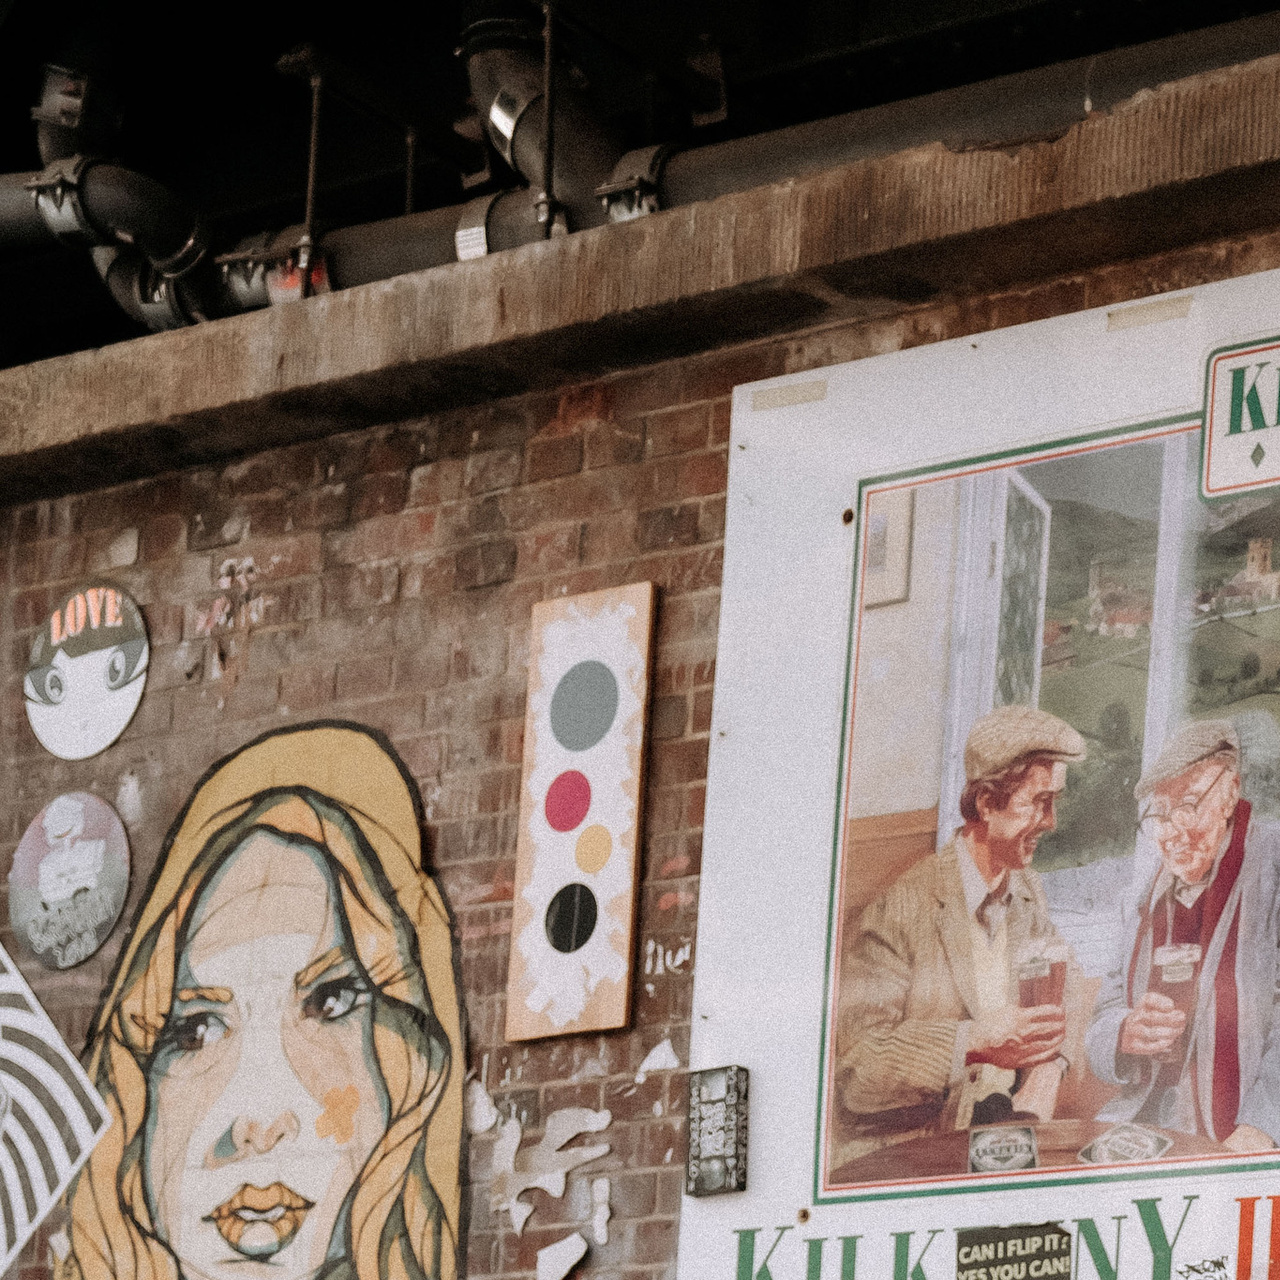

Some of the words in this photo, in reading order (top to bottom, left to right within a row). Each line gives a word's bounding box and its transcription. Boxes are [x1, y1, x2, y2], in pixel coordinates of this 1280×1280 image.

[50, 586, 122, 647] LOVE
[958, 1242, 995, 1265] CAN
[997, 1241, 1005, 1259] I
[1006, 1236, 1043, 1258] FLIP
